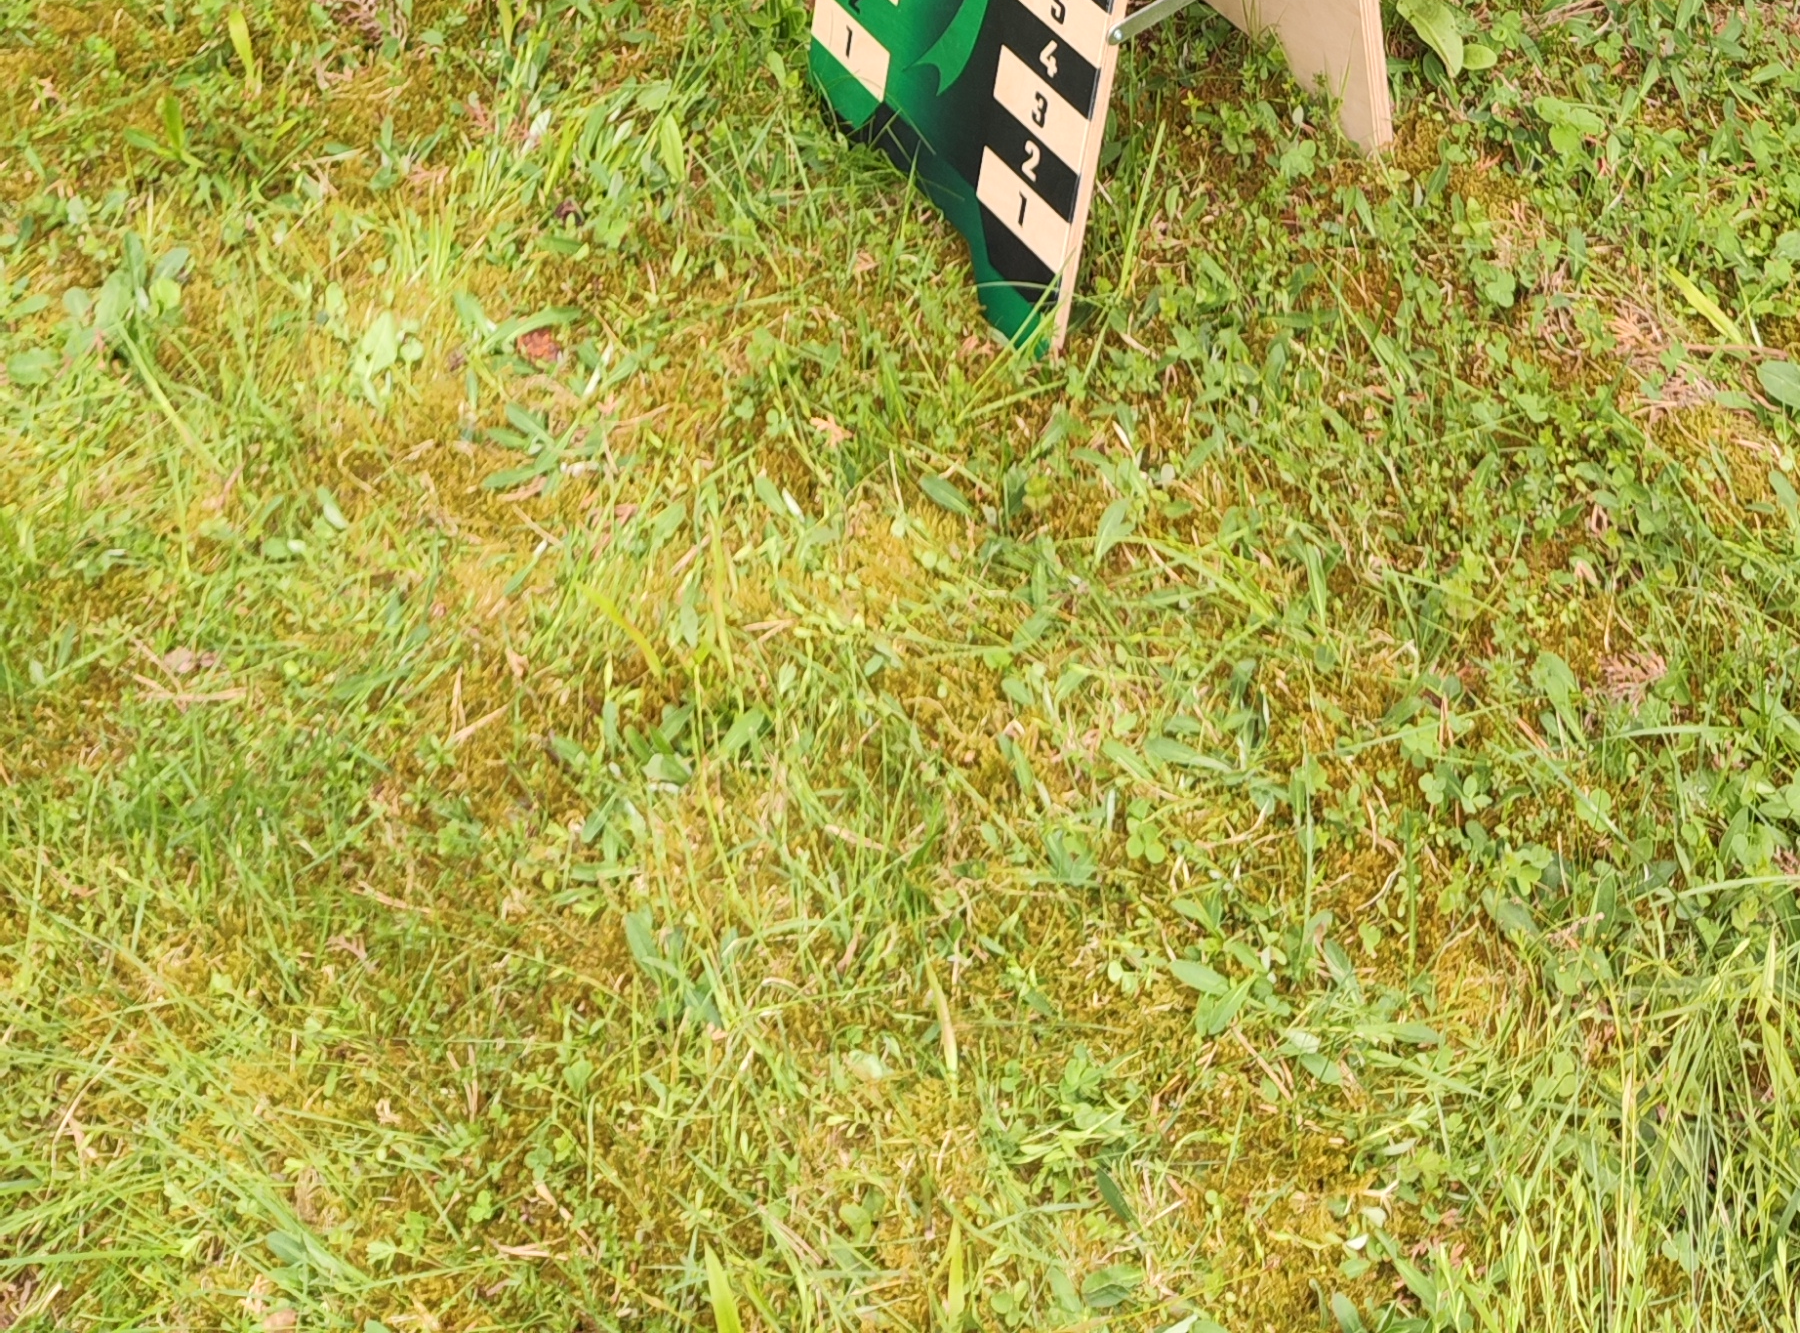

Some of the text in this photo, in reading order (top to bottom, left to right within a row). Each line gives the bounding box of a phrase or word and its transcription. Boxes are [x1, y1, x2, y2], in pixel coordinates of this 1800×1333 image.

[845, 25, 853, 58] 1
[1039, 40, 1058, 79] 4
[1031, 91, 1049, 129] 3
[1021, 140, 1041, 182] 2
[1017, 191, 1027, 227] 1
